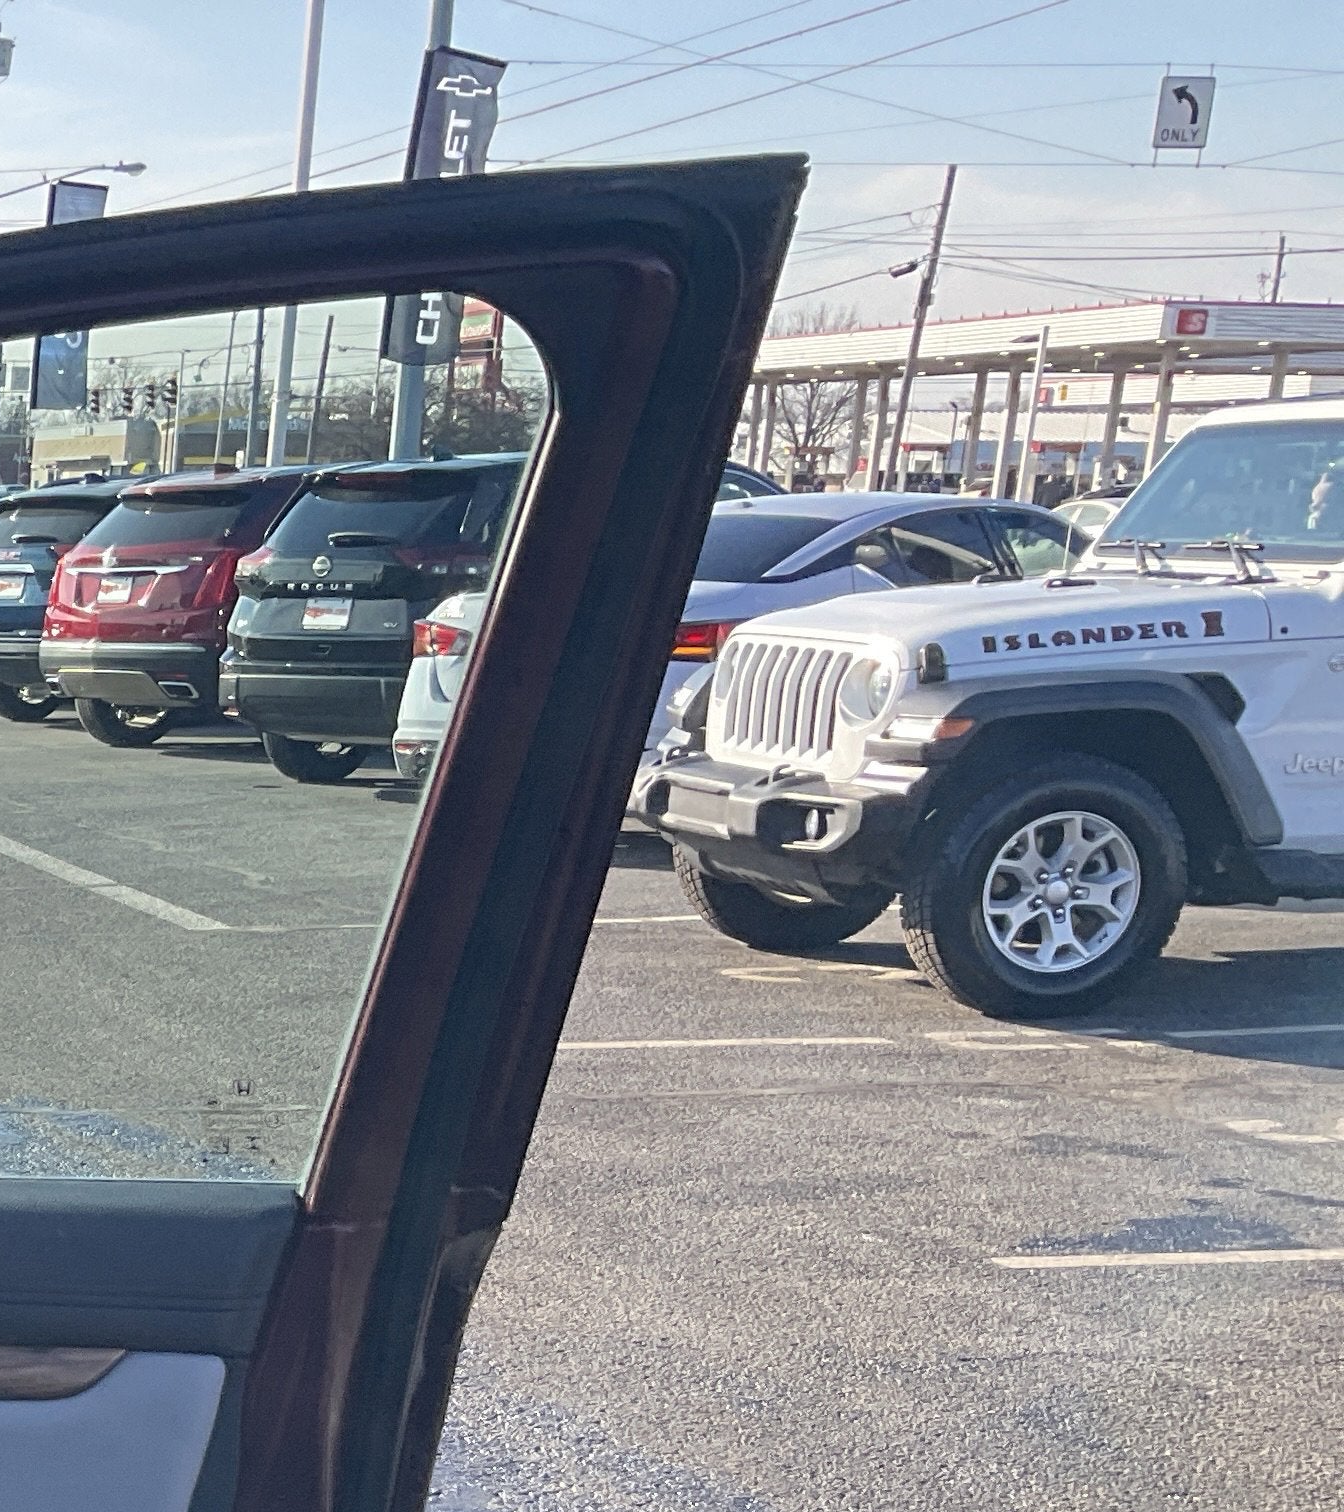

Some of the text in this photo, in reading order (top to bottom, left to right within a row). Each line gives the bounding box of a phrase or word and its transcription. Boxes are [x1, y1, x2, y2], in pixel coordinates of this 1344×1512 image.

[1160, 128, 1200, 142] ONLY
[287, 583, 353, 591] ROGUE
[982, 620, 1190, 654] ISLANDER
[1283, 752, 1344, 777] Jeep
